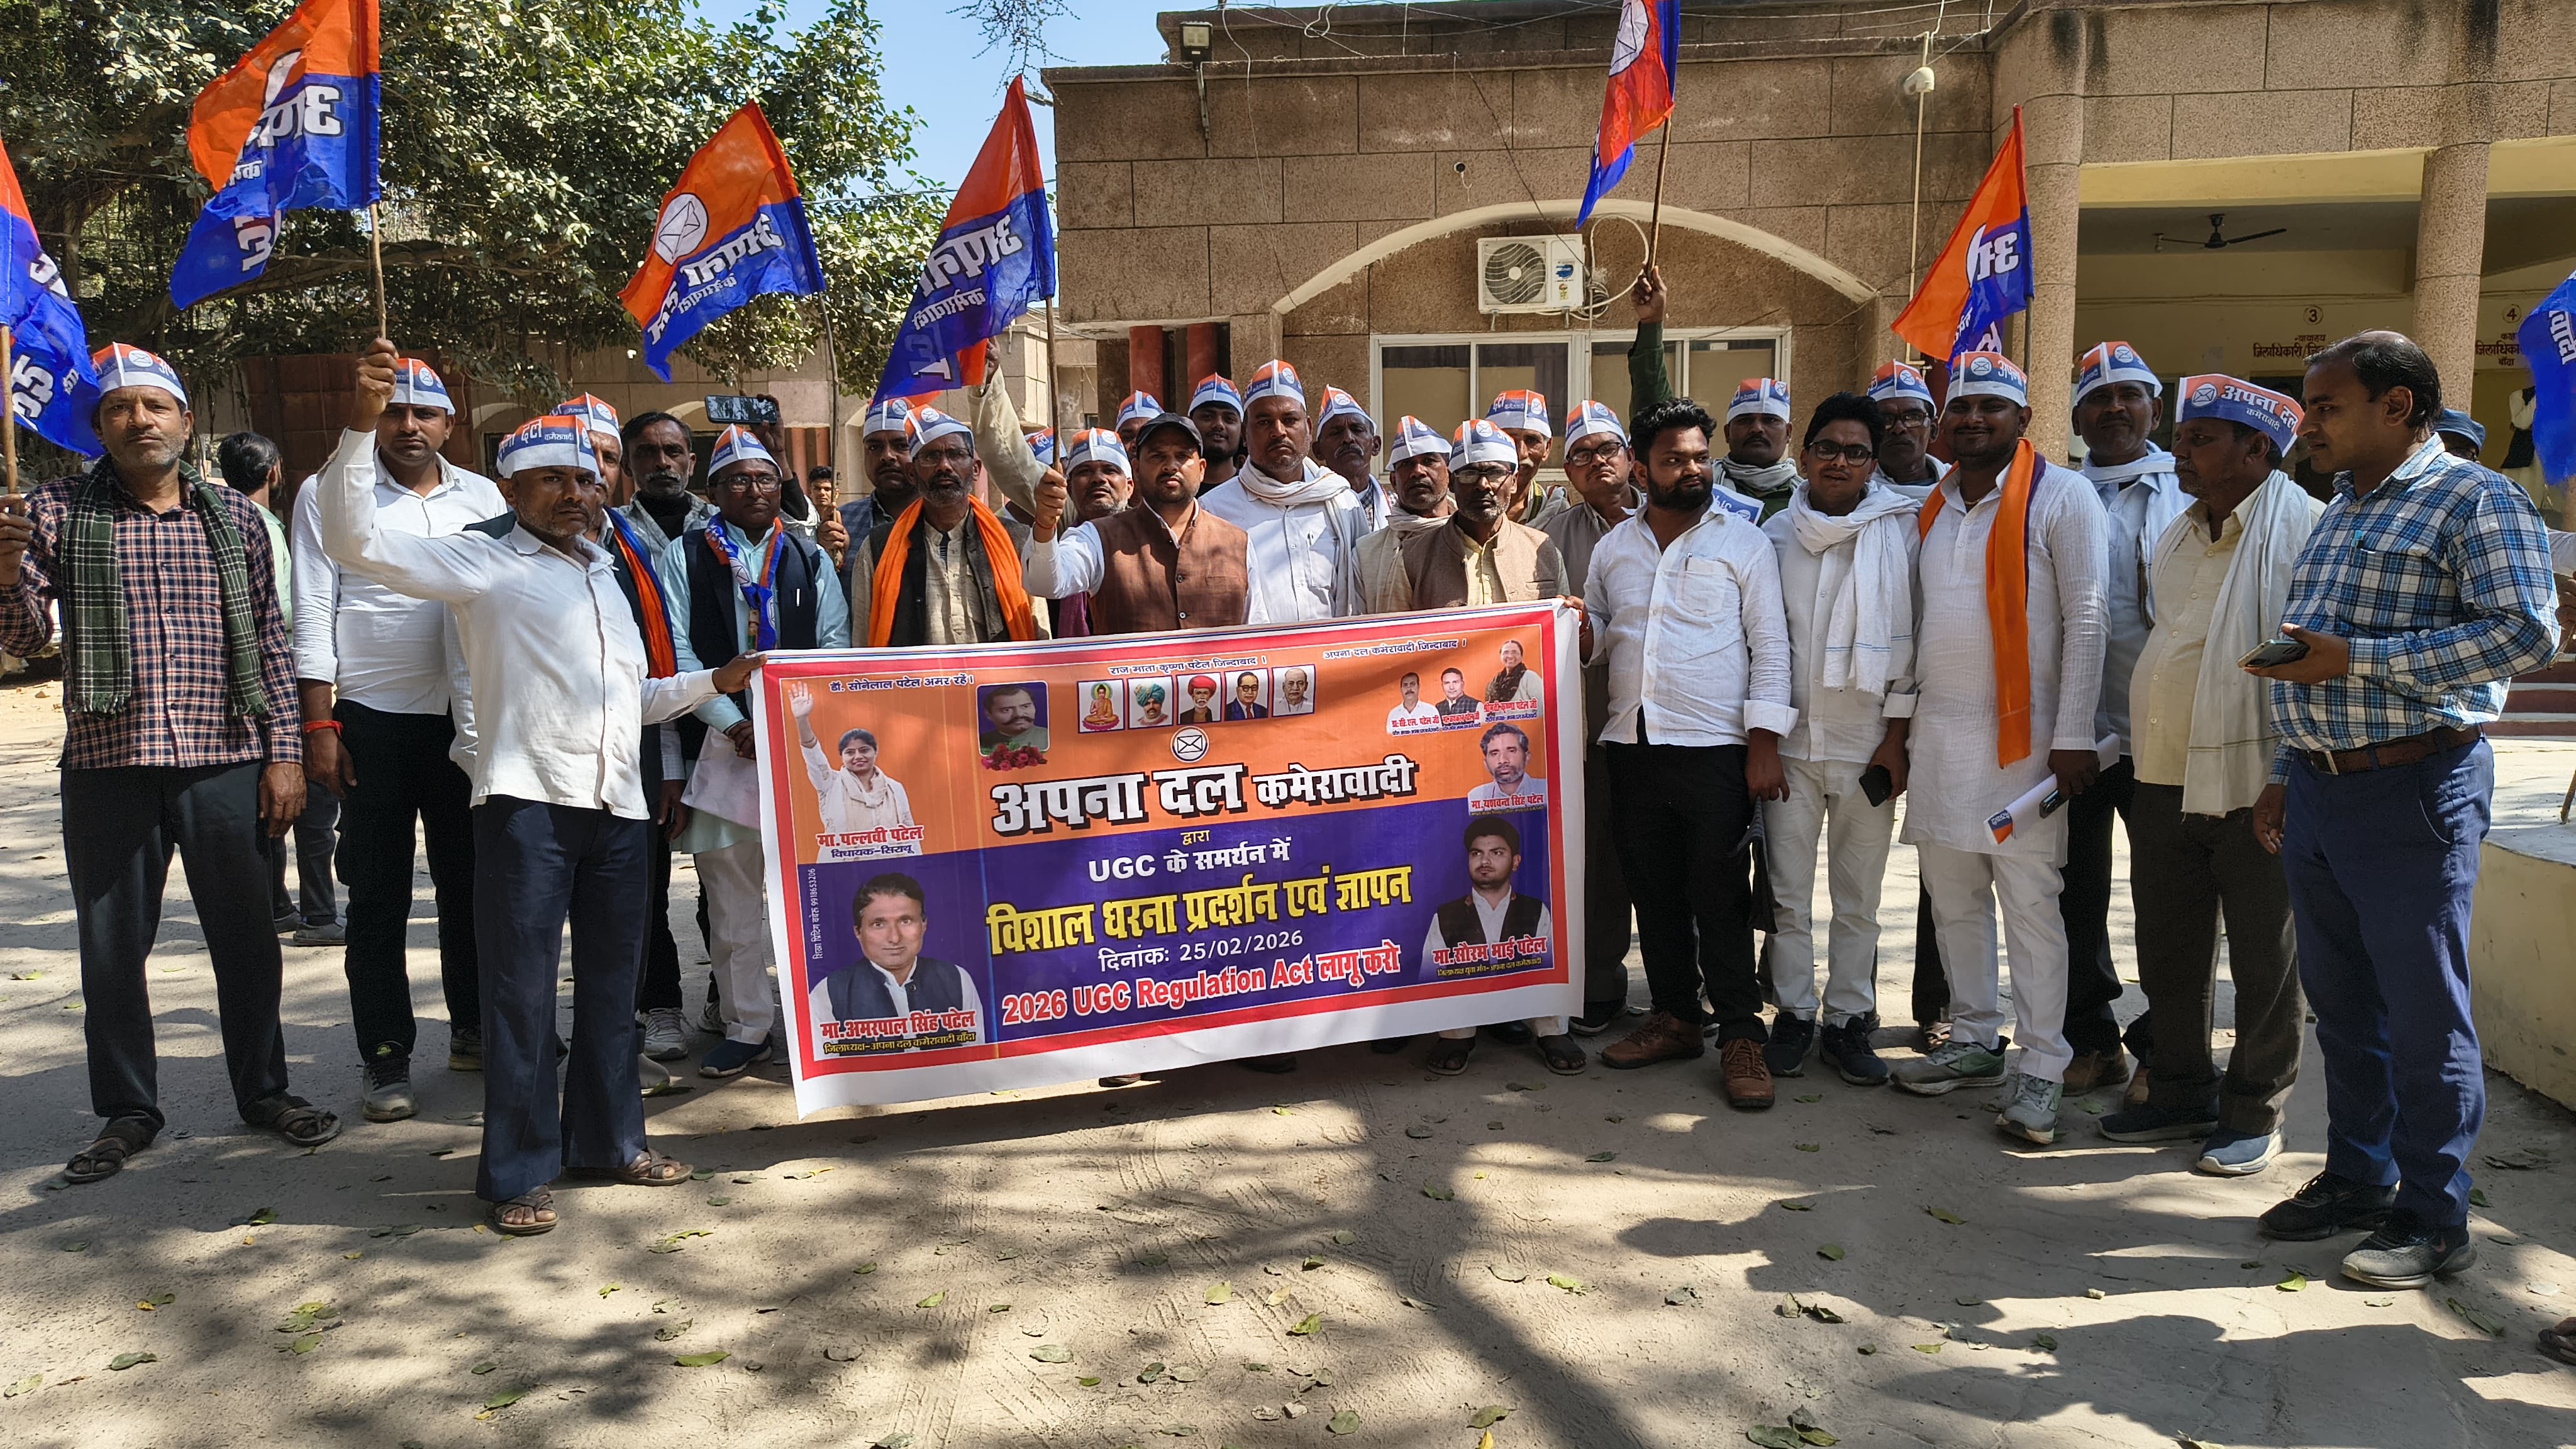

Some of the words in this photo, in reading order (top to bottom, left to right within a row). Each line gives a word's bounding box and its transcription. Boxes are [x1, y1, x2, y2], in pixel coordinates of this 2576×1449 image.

[2475, 340, 2522, 356] जिलाधिका
[2221, 384, 2279, 415] अपना
[2281, 405, 2299, 433] दल
[521, 418, 543, 443] दल
[2245, 408, 2280, 432] कमेरावादी
[1324, 650, 1350, 659] अपना
[1371, 642, 1415, 655] कमेरावादी
[1109, 666, 1129, 675] राज
[1132, 664, 1157, 674] माता
[1159, 662, 1185, 673] कृष्णा
[1187, 659, 1210, 670] पटेल
[848, 679, 892, 691] सोनेलाल
[896, 677, 920, 687] पटेल
[924, 676, 950, 687] अमर
[991, 773, 1148, 836] अपना
[1152, 763, 1248, 817] दल
[1252, 753, 1419, 809] कमेरावादी
[1527, 793, 1544, 804] पटेल
[890, 824, 923, 841] पटेल
[1180, 830, 1211, 846] द्वारा
[1088, 854, 1156, 882] UGC
[1163, 848, 1189, 873] के
[1193, 841, 1266, 870] समर्थन
[1270, 836, 1292, 862] में
[985, 902, 1096, 955] विशाल
[1102, 894, 1179, 940] धरना
[1183, 874, 1279, 933] प्रदर्शन
[1283, 865, 1331, 918] एवं
[1335, 865, 1412, 911] ज्ञापन
[1098, 943, 1170, 972] दिनांक:
[1179, 930, 1304, 962] 25/02/2026
[1516, 935, 1547, 955] पटेल
[1003, 989, 1068, 1026] 2026
[1073, 982, 1131, 1014] UGC
[1136, 965, 1267, 1010] Regulation
[1270, 953, 1313, 989] Act
[1316, 948, 1365, 989] लागू
[1360, 939, 1401, 976] करो
[910, 1011, 938, 1034] सिंह
[940, 1009, 975, 1030] पटेल
[897, 1040, 911, 1049] दल
[913, 1034, 956, 1048] कमेरावादी
